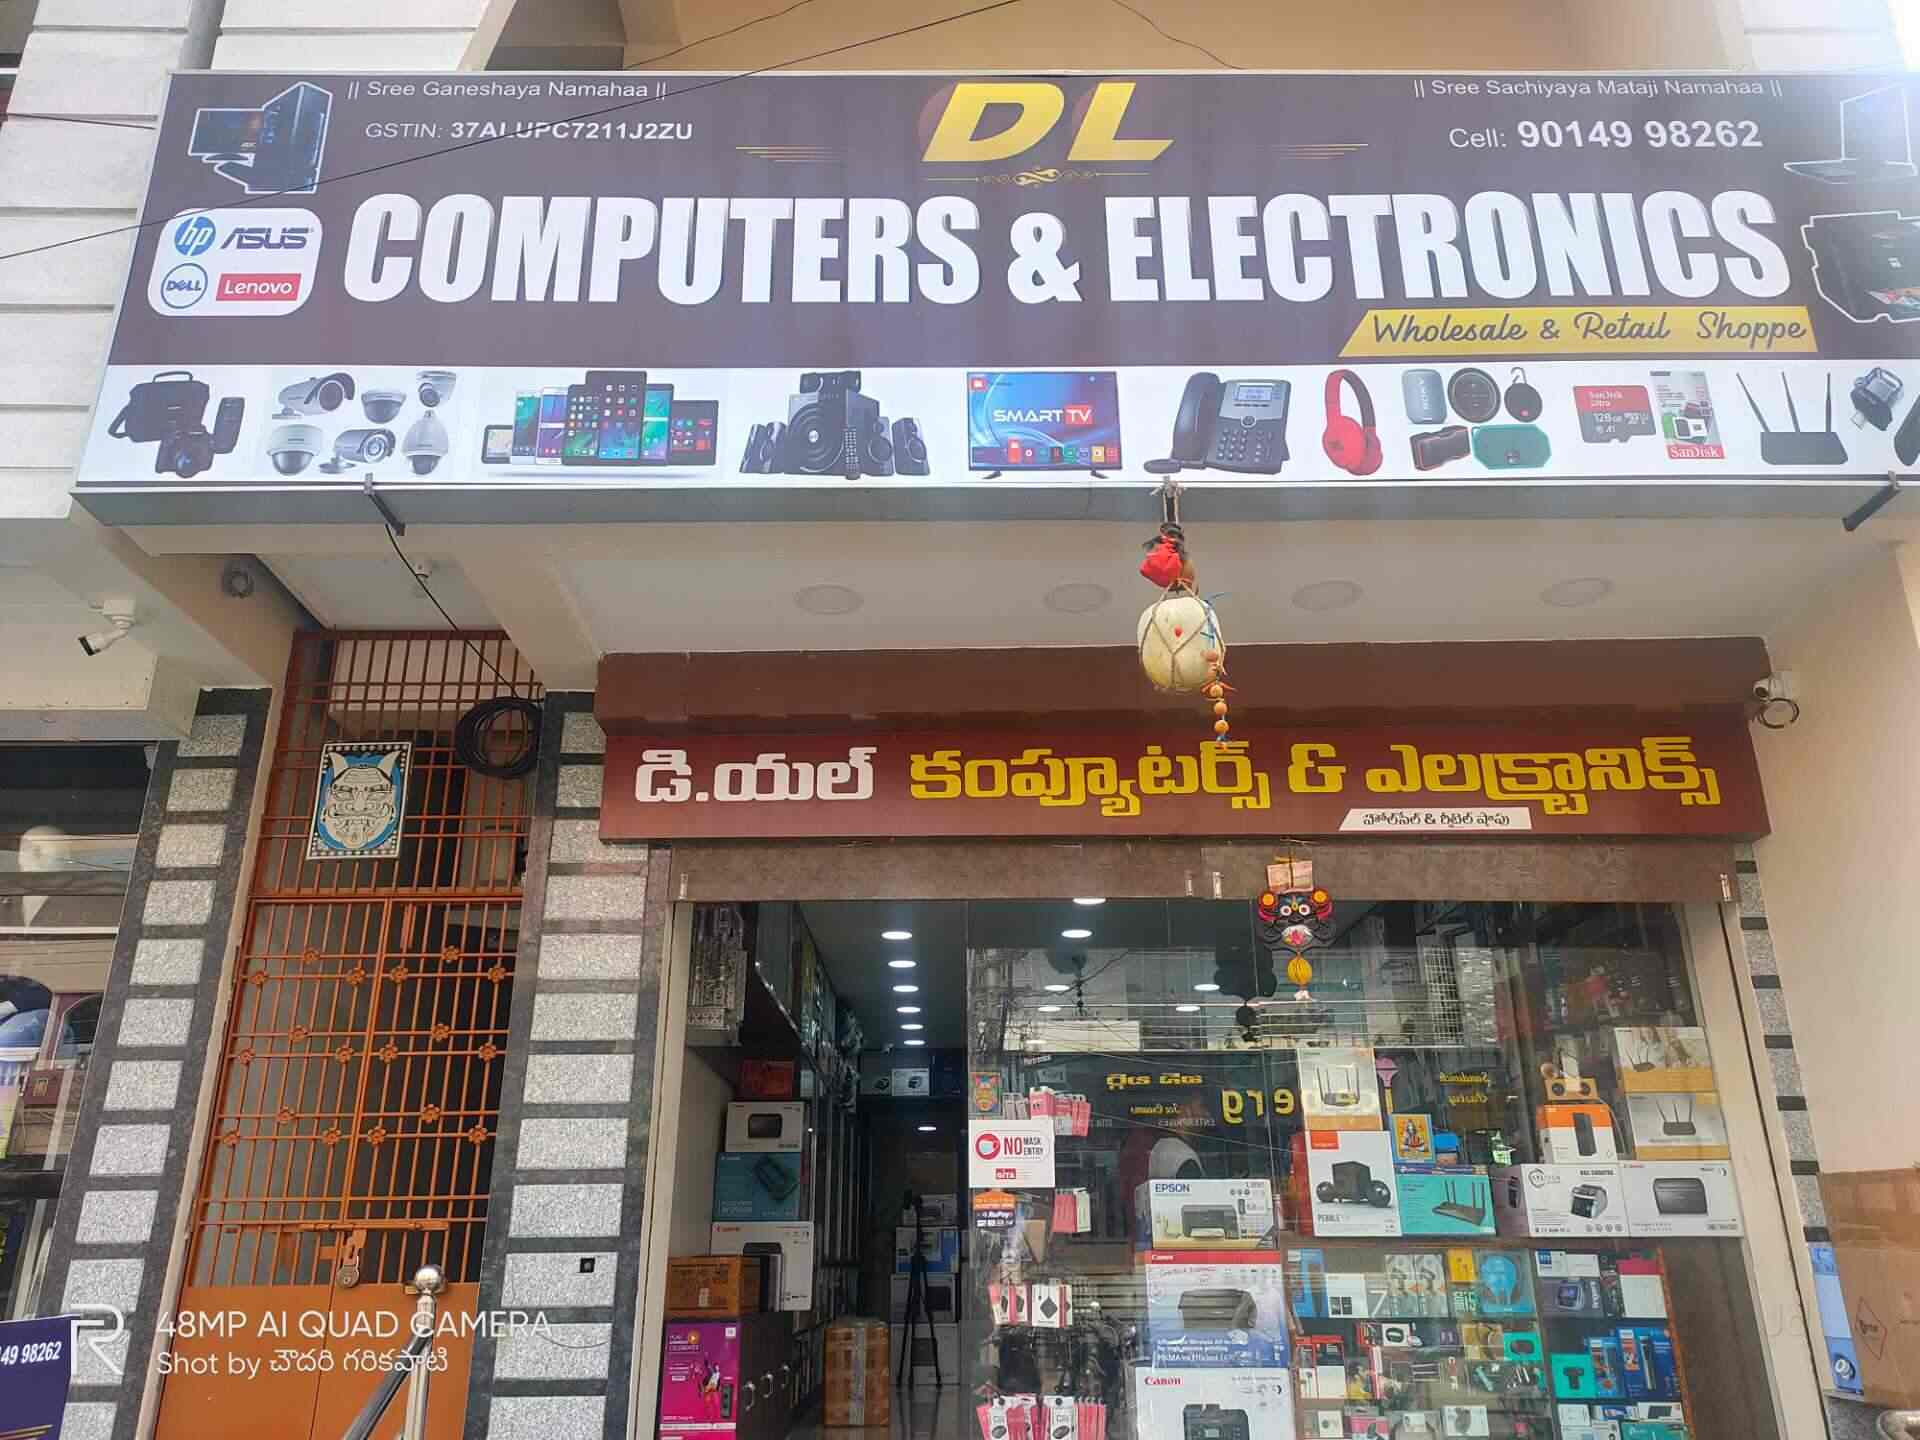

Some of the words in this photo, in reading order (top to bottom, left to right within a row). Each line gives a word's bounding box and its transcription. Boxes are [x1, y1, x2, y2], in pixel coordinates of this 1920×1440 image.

[367, 81, 416, 97] Sree
[423, 81, 541, 100] Ganeshaya
[549, 81, 648, 97] Namahaa
[1431, 79, 1480, 95] Sree
[1486, 79, 1591, 98] Sachiyaya
[1598, 79, 1659, 98] Mataji
[1665, 79, 1763, 96] Namahaa
[365, 122, 442, 139] GSTIN:
[921, 82, 1175, 162] DL
[1449, 127, 1507, 149] Cell:
[1517, 119, 1633, 148] 90149
[1644, 119, 1763, 148] 98262
[220, 227, 310, 250] ASUS
[343, 192, 981, 305] COMPUTERS
[1007, 211, 1083, 304] &
[1104, 189, 1792, 302] ELECTRONICS
[166, 279, 203, 292] DELL
[223, 279, 294, 295] Lenovo
[1373, 313, 1528, 343] Wholesale
[1540, 317, 1560, 340] &
[1573, 311, 1672, 341] Retail
[1695, 311, 1807, 350] Shoppe
[992, 409, 1064, 422] SMART
[1066, 409, 1093, 423] TV
[1670, 445, 1719, 458] SanDisk
[908, 740, 1271, 818] కంప్యూటర్స్
[1288, 743, 1347, 793] &
[1364, 736, 1721, 816] ఎలక్ట్రానిక్స్
[1003, 1136, 1023, 1156] NO
[1154, 1183, 1191, 1193] EPSON
[21, 1341, 62, 1364] 98262
[1143, 1375, 1184, 1386] Canon
